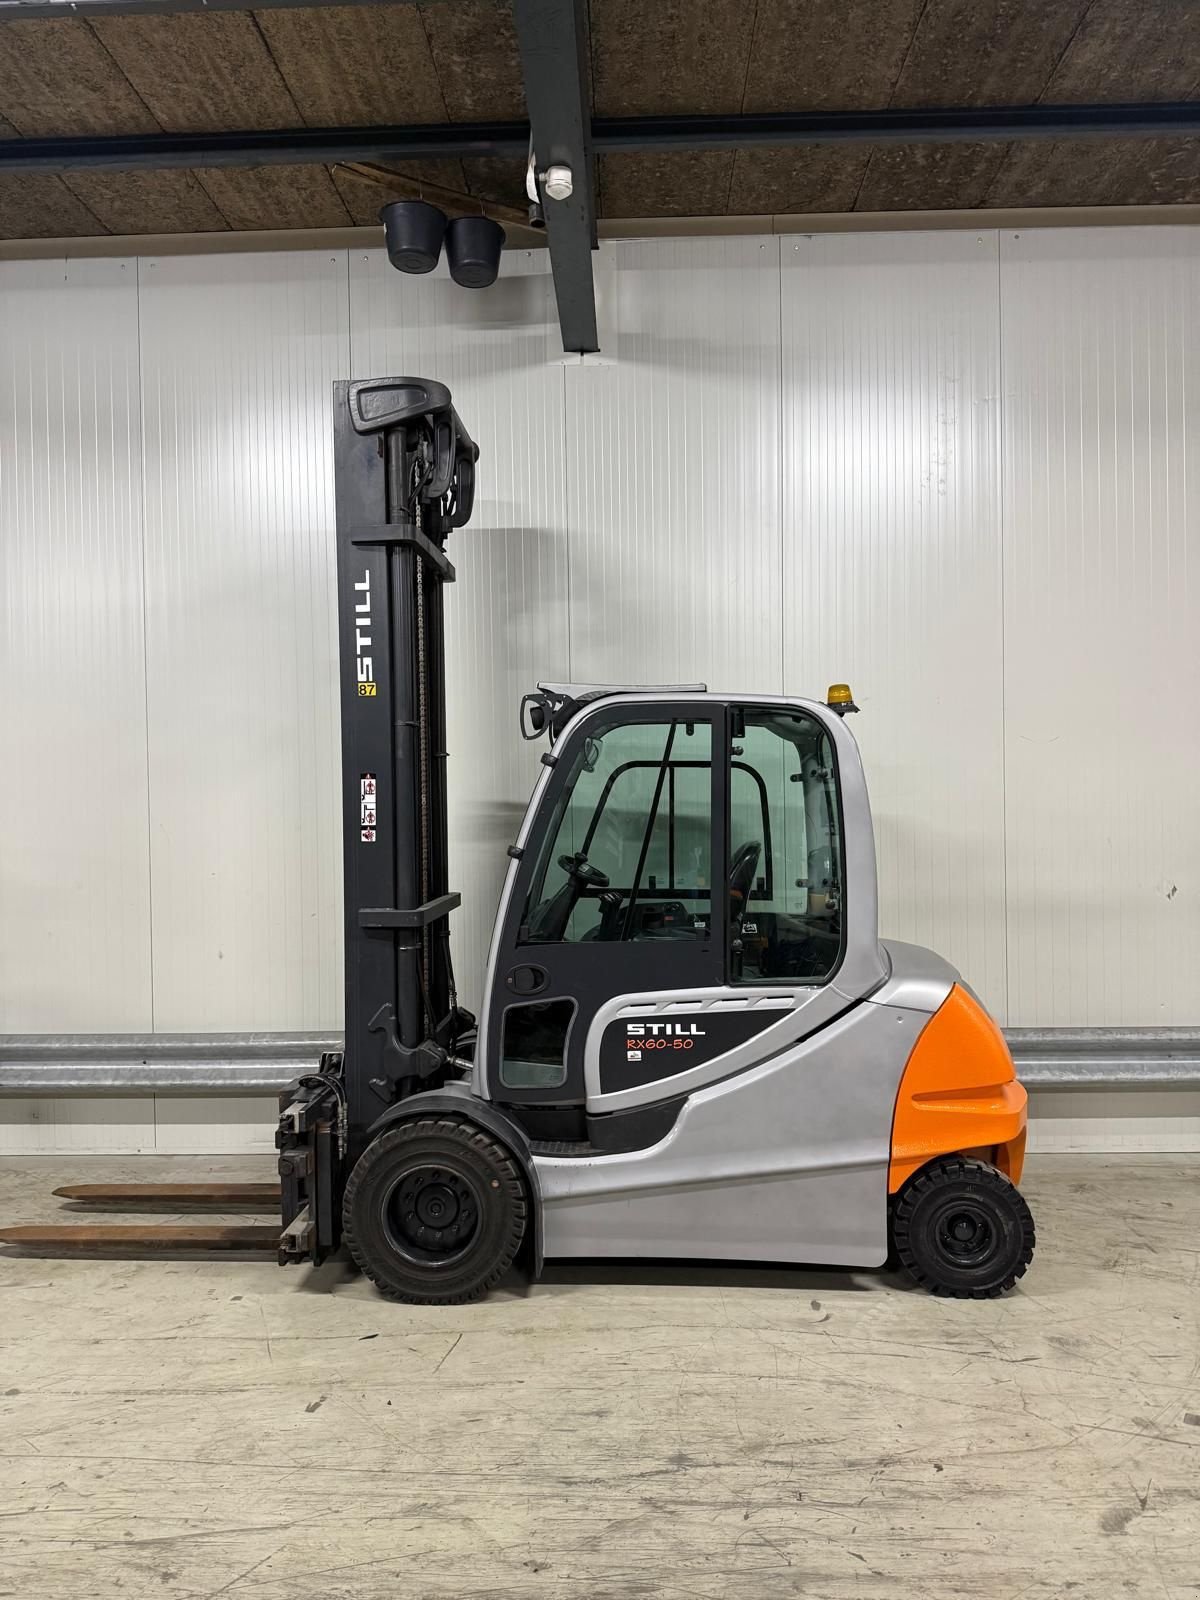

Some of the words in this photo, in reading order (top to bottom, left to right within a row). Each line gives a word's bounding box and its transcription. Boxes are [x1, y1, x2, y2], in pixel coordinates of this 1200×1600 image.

[354, 569, 373, 682] STILL
[359, 685, 375, 695] 87
[627, 1023, 706, 1035] STILL
[627, 1039, 694, 1049] RX60-50
